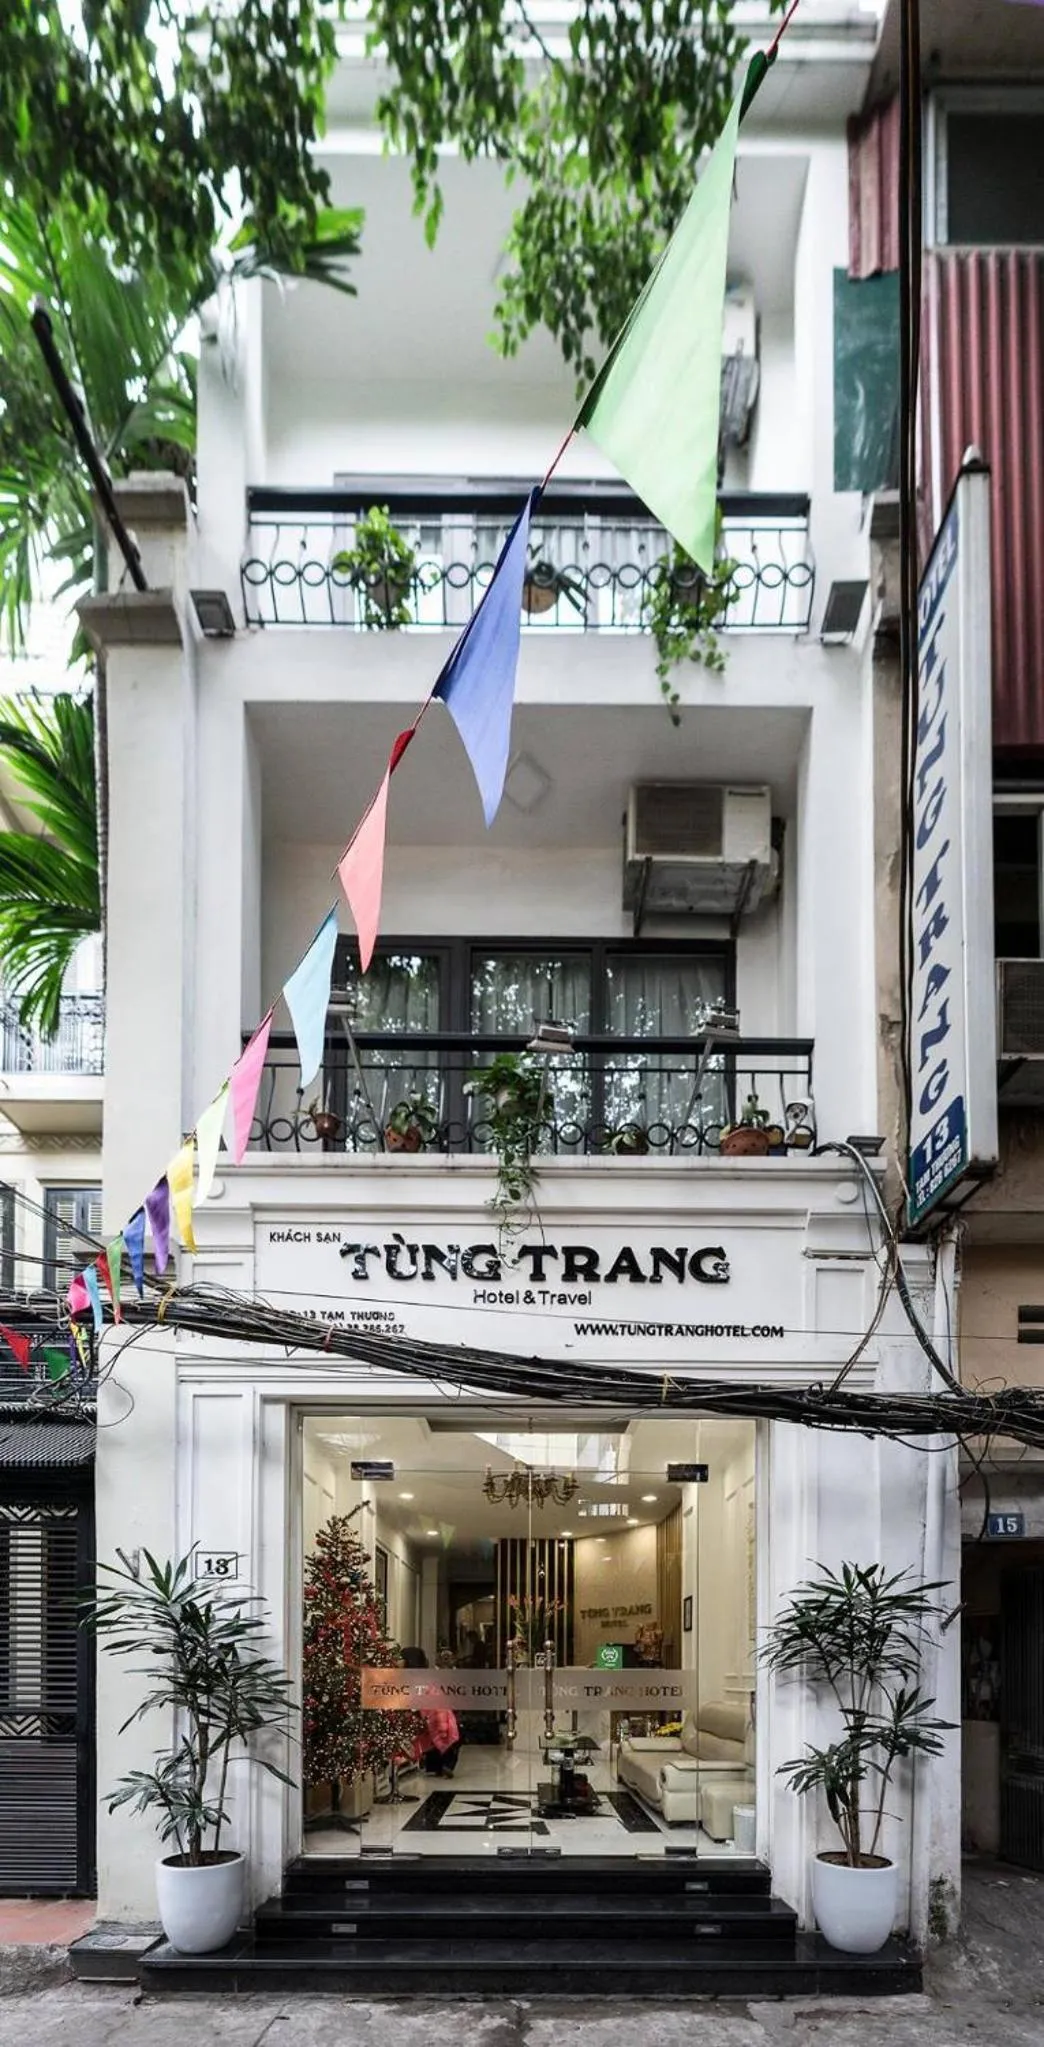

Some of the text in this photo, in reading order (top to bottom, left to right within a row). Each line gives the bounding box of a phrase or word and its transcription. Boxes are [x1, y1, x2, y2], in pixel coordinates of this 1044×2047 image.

[915, 839, 951, 1115] TRANG
[922, 1116, 950, 1165] 13
[269, 1229, 342, 1245] KHÁCH SẠN
[339, 1233, 731, 1284] TÙNG TRANG
[473, 1289, 593, 1306] Hotel & Travel
[574, 1322, 785, 1338] WWW.TUNGTRANGHOTEL.COM
[996, 1517, 1019, 1534] 15
[204, 1558, 229, 1576] 13
